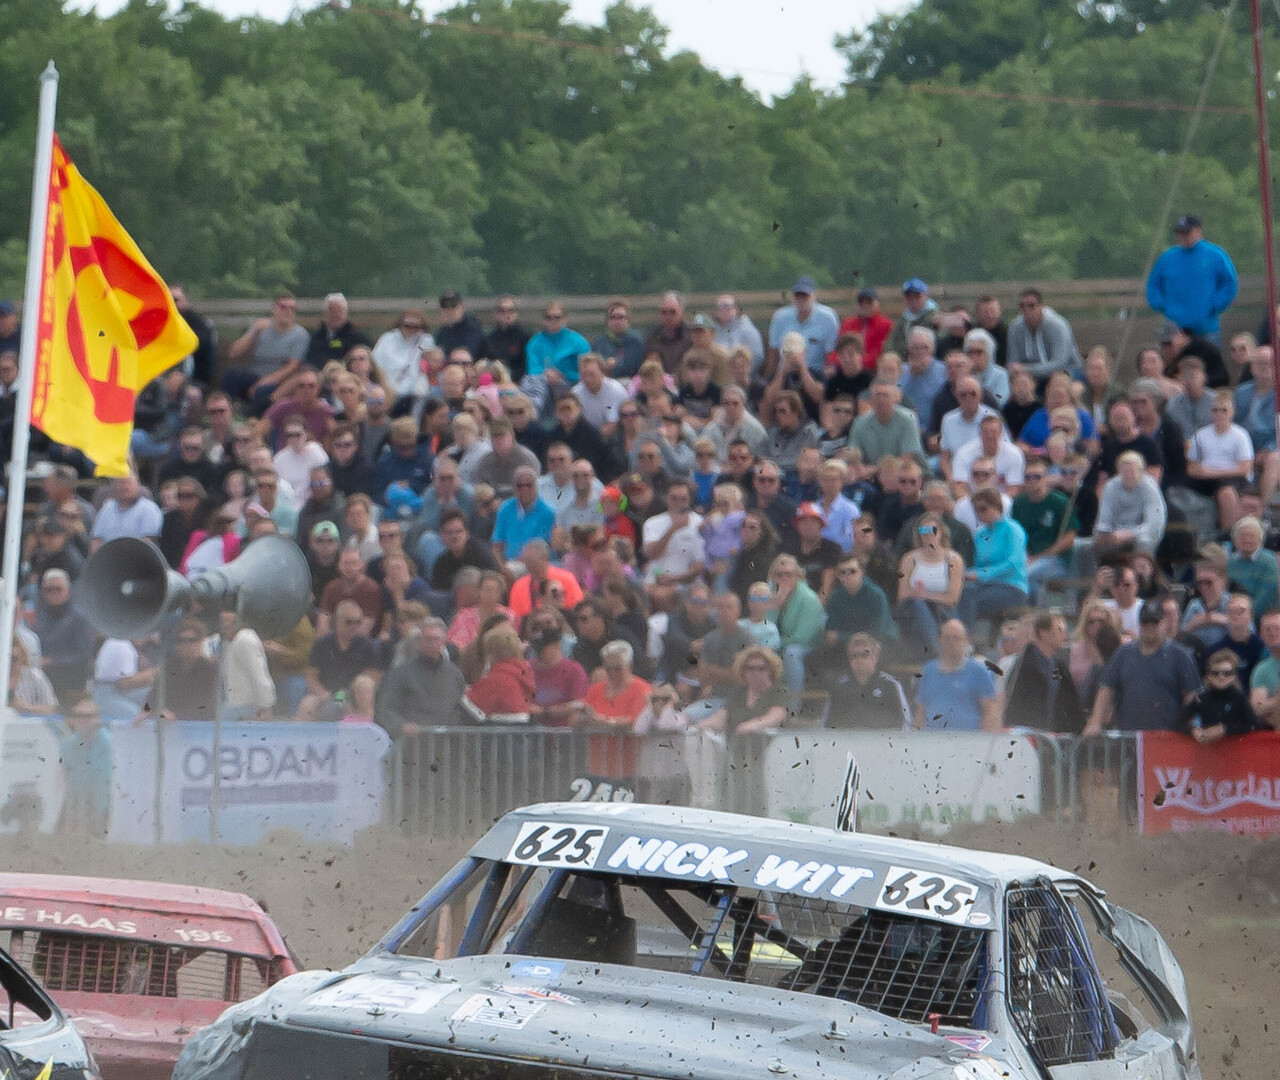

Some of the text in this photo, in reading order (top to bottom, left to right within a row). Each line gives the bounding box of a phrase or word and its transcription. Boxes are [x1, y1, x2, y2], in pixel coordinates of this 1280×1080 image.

[183, 743, 338, 781] OBDAM
[513, 825, 975, 917] 625 NICK WIT 625
[35, 909, 138, 934] HAAS
[173, 927, 235, 944] 196
